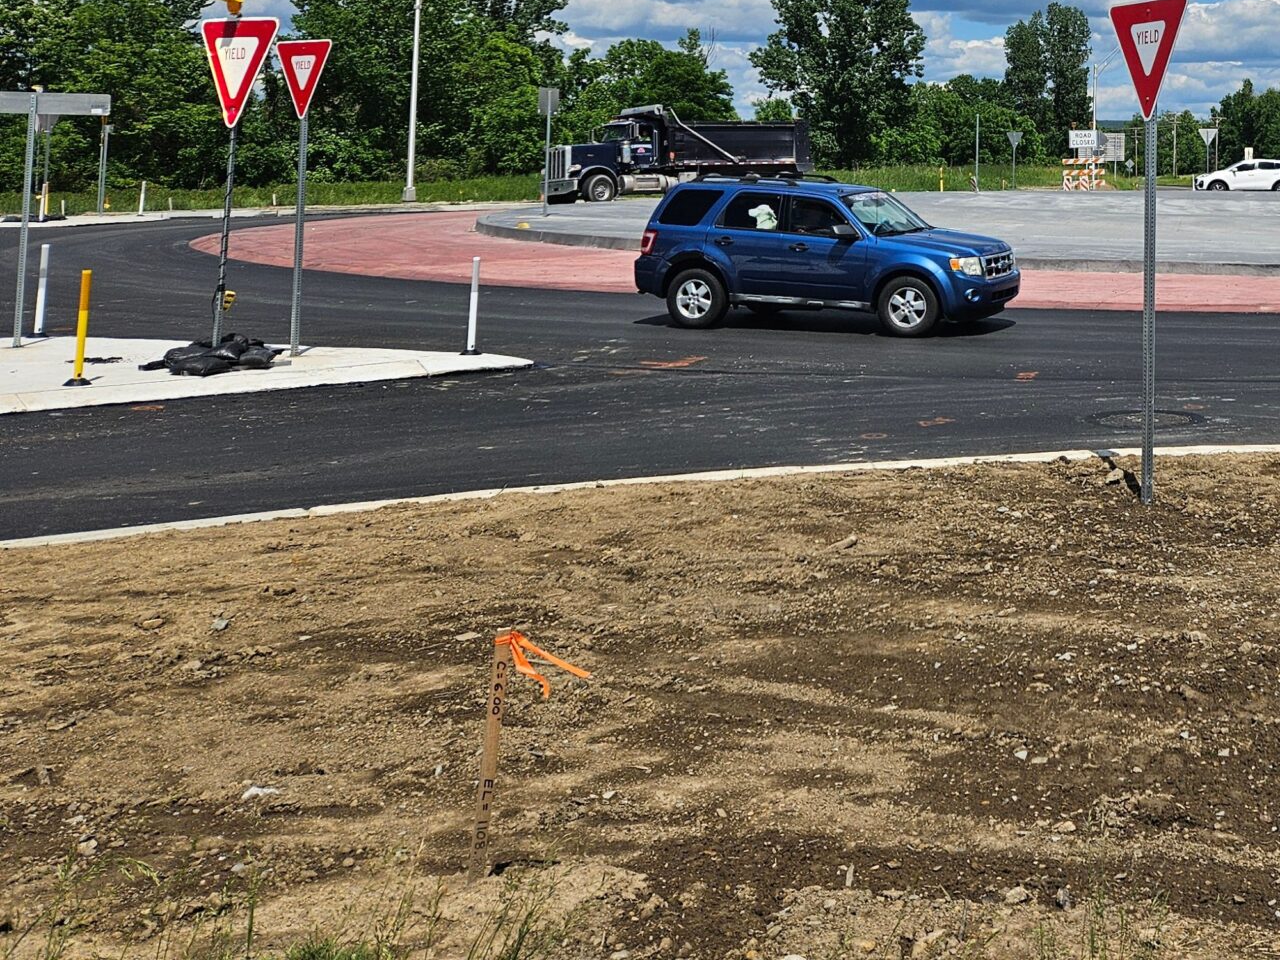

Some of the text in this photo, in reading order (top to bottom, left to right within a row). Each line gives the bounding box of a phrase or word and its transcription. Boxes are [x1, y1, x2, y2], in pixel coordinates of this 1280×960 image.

[1136, 29, 1159, 45] YIELD
[225, 47, 246, 60] YIELD
[295, 60, 311, 70] YIELD
